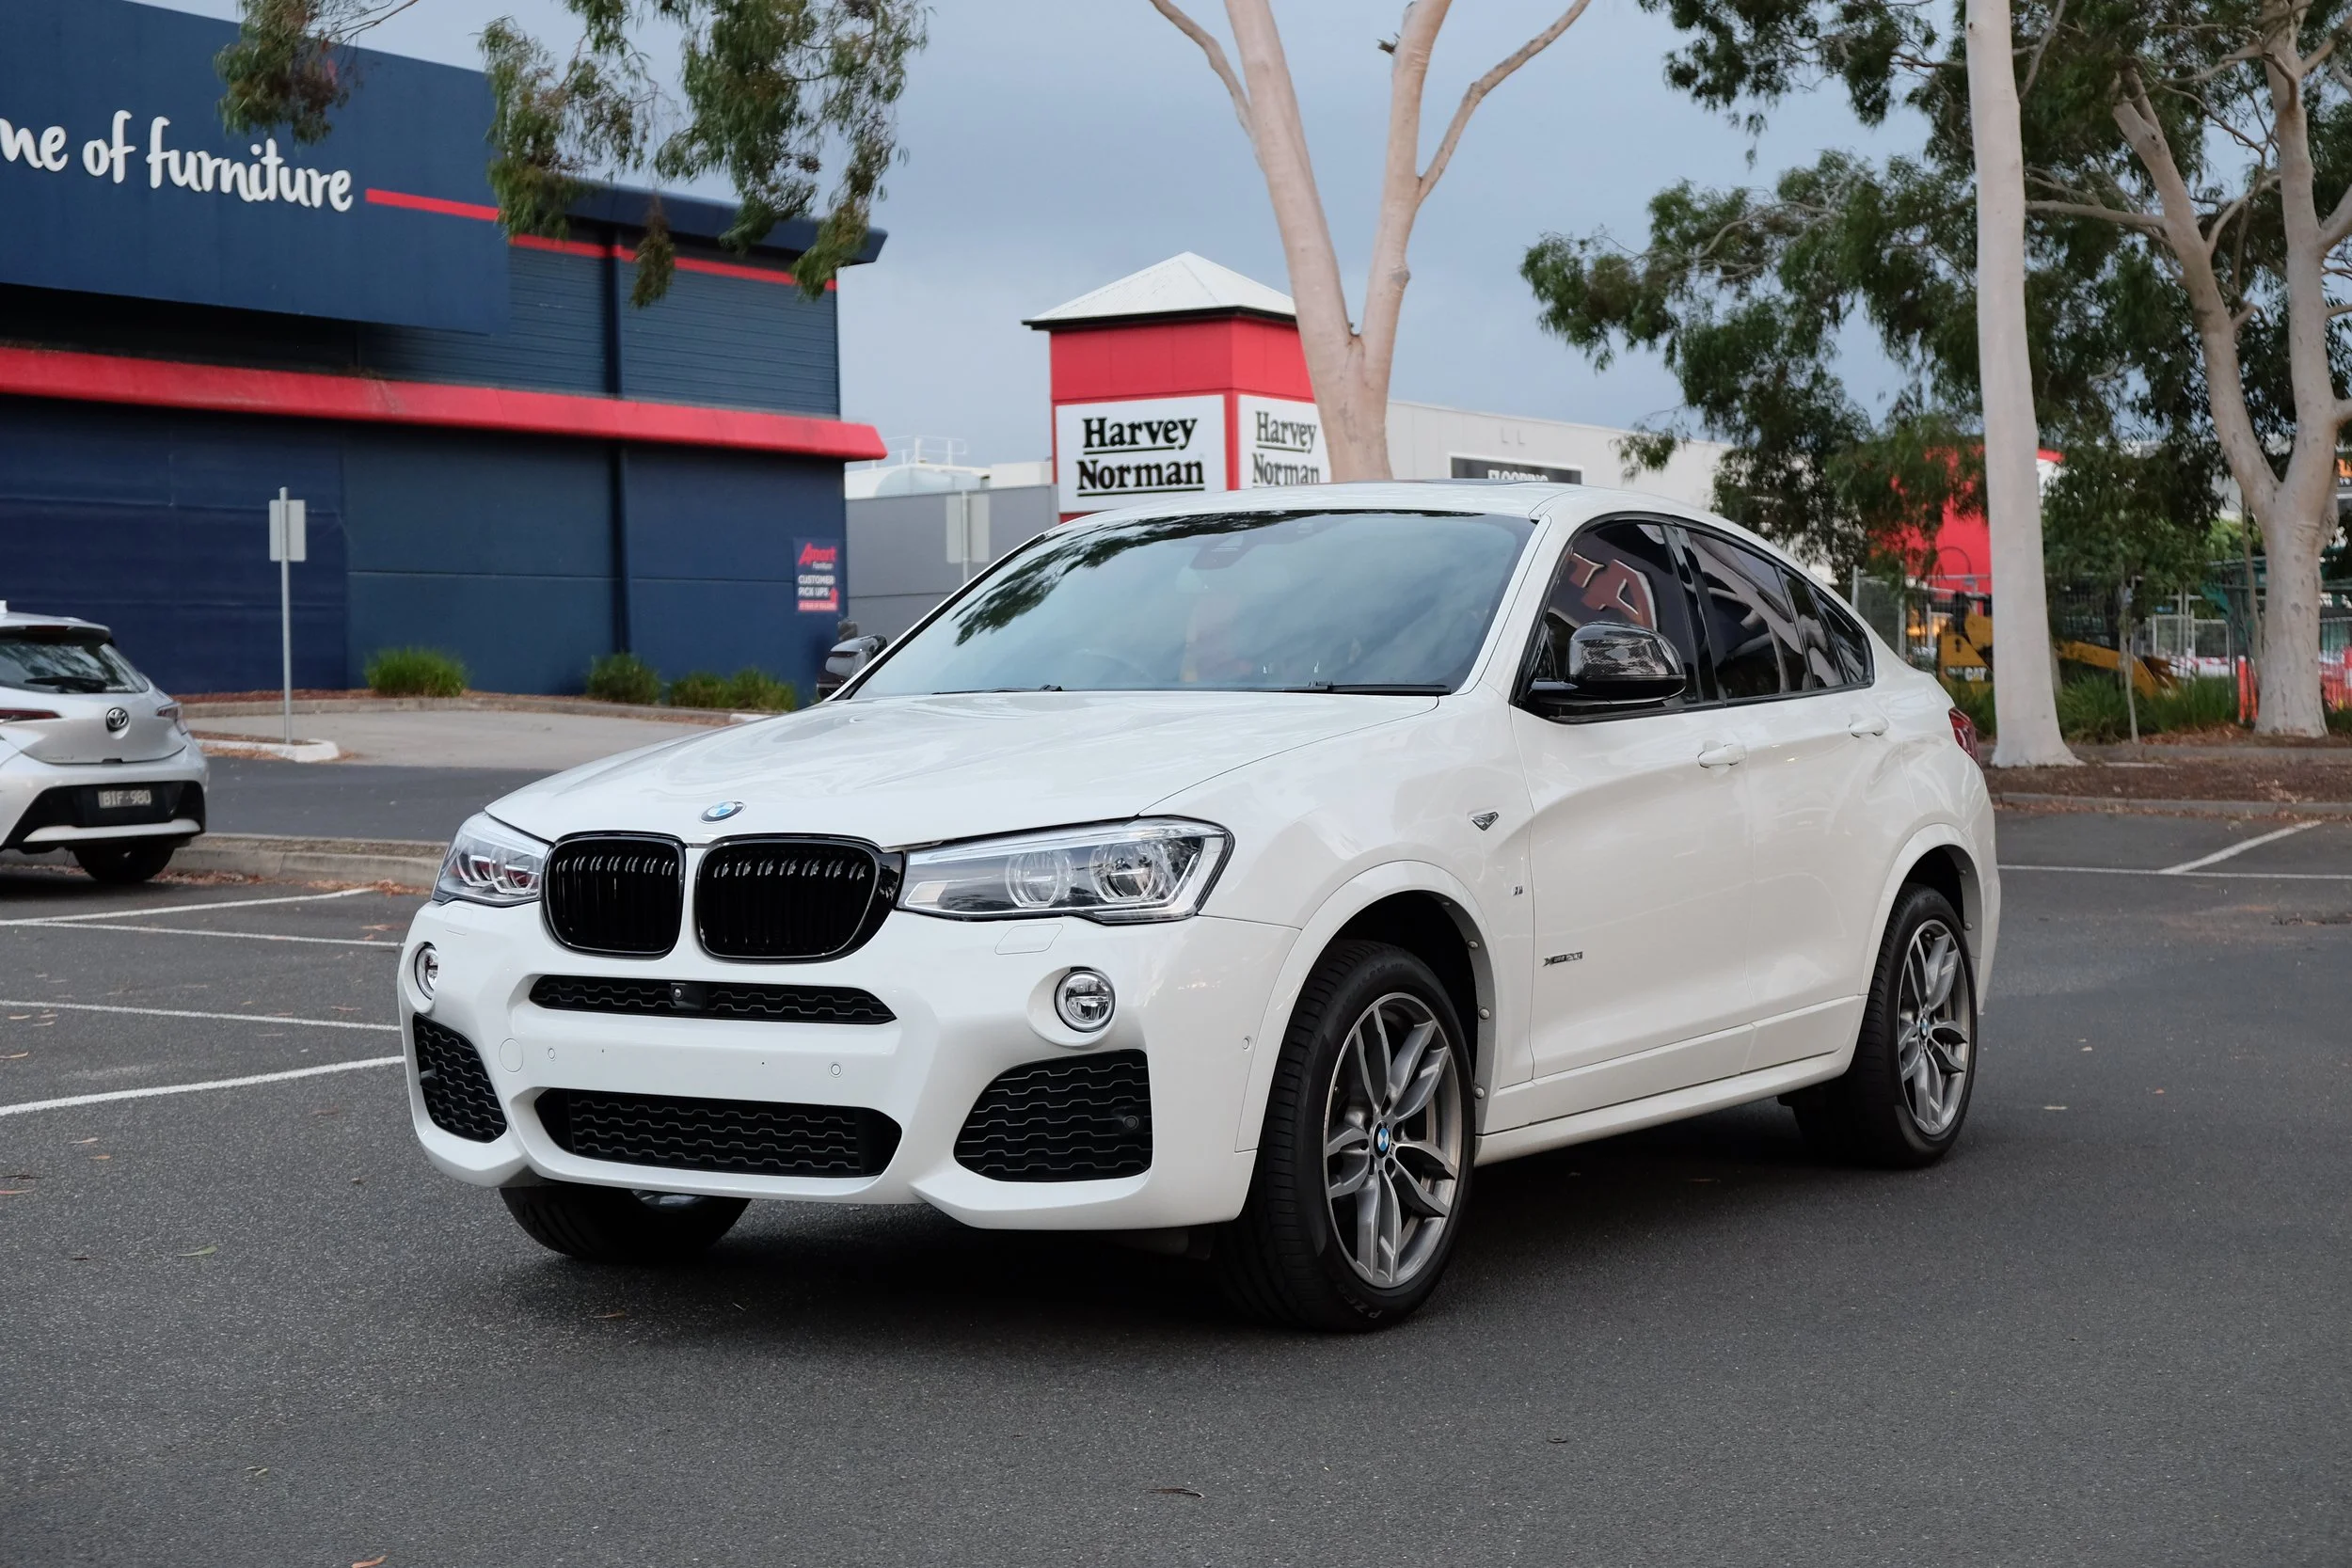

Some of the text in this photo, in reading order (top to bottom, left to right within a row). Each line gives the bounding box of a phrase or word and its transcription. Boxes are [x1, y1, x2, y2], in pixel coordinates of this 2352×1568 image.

[82, 109, 136, 184] of
[146, 117, 354, 212] furniture
[1082, 417, 1198, 451] Harvey
[1254, 410, 1317, 453] Harvey
[1076, 458, 1204, 491] Norman
[1251, 451, 1320, 485] Norman
[798, 575, 835, 585] CUSTOMER
[798, 586, 814, 597] PICK
[1964, 666, 1987, 682] CAT
